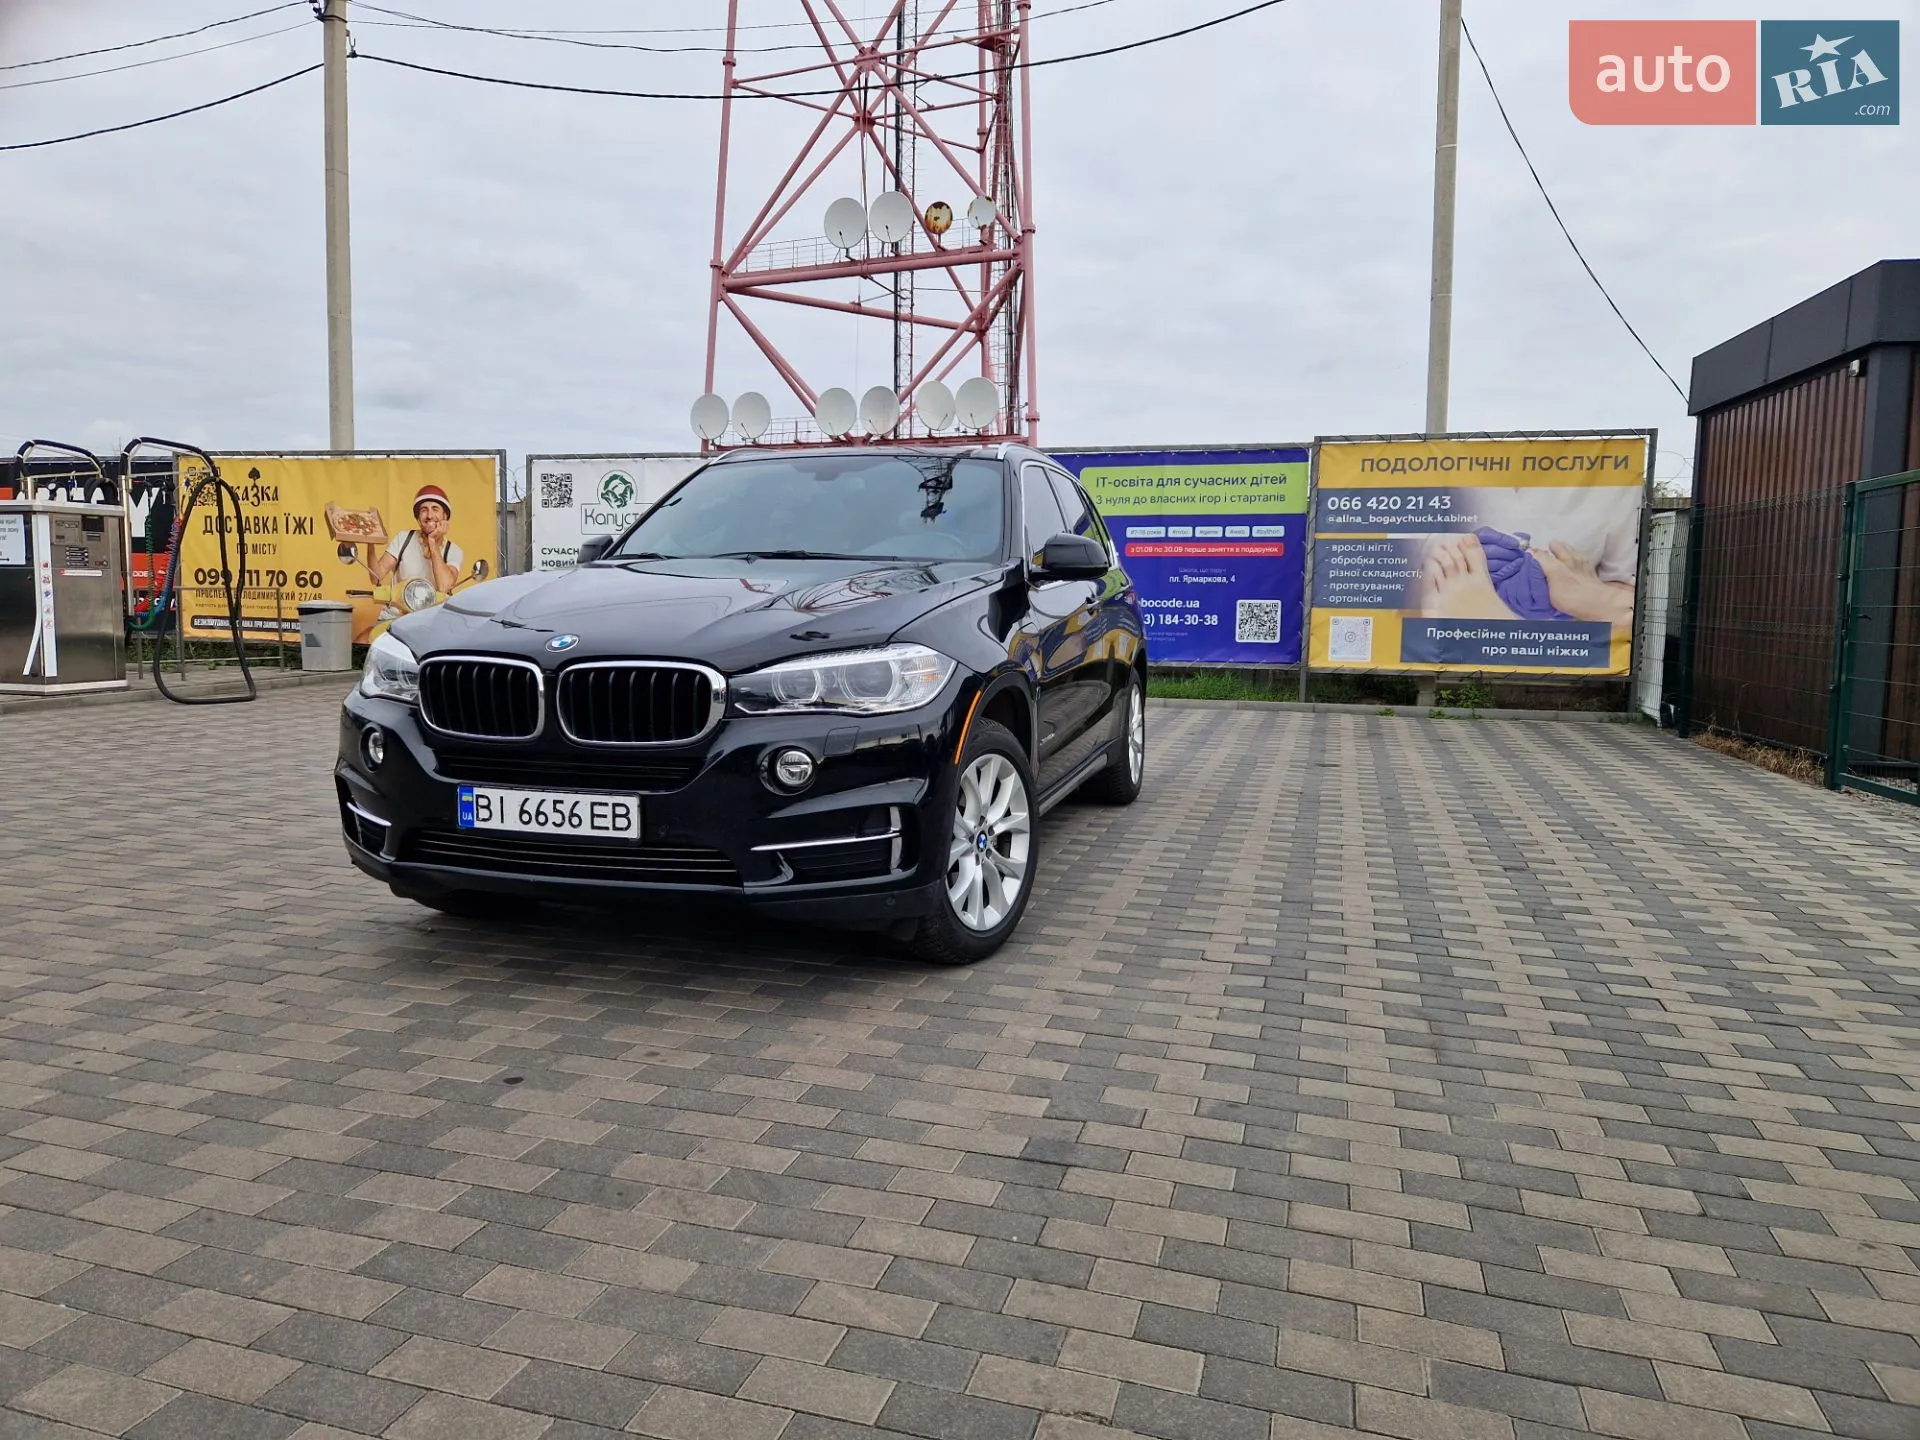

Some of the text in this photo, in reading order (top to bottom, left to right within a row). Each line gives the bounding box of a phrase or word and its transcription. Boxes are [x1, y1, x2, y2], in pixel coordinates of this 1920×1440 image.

[1361, 454, 1630, 475] ПОДОЛОГІЧНІ ПОСЛУГИ
[1156, 477, 1181, 488] для
[1184, 476, 1247, 489] сучасних
[1250, 473, 1287, 487] дітей
[1105, 495, 1131, 507] нуля
[1133, 496, 1147, 506] до
[1150, 495, 1196, 505] власних
[1199, 493, 1221, 506] ігор
[1224, 492, 1227, 502] і
[1230, 491, 1286, 505] стартапів
[1327, 495, 1452, 511] 066 420 21 43
[284, 512, 314, 535] ЇЖІ
[584, 508, 644, 531] Капуст
[252, 543, 277, 554] МІСТУ
[541, 547, 580, 555] СУЧАСН
[1332, 544, 1366, 553] врослі
[1368, 543, 1394, 553] нігті;
[1331, 556, 1375, 567] обробка
[266, 570, 288, 587] 70
[295, 571, 323, 588] 60
[1169, 575, 1181, 583] пл.
[1183, 574, 1229, 584] Ярмаркова,
[1329, 569, 1423, 579] різної складності;
[1329, 582, 1405, 592] протезування;
[195, 588, 227, 599] ПРОСПЕК
[1329, 593, 1383, 604] ортоніксія
[1144, 613, 1219, 627] 3) 184-30-38
[1427, 627, 1590, 643] Професійне піклування
[1482, 645, 1589, 657] про ваші ніжки
[462, 812, 473, 821] UA
[475, 794, 632, 831] BI 6656 EB
